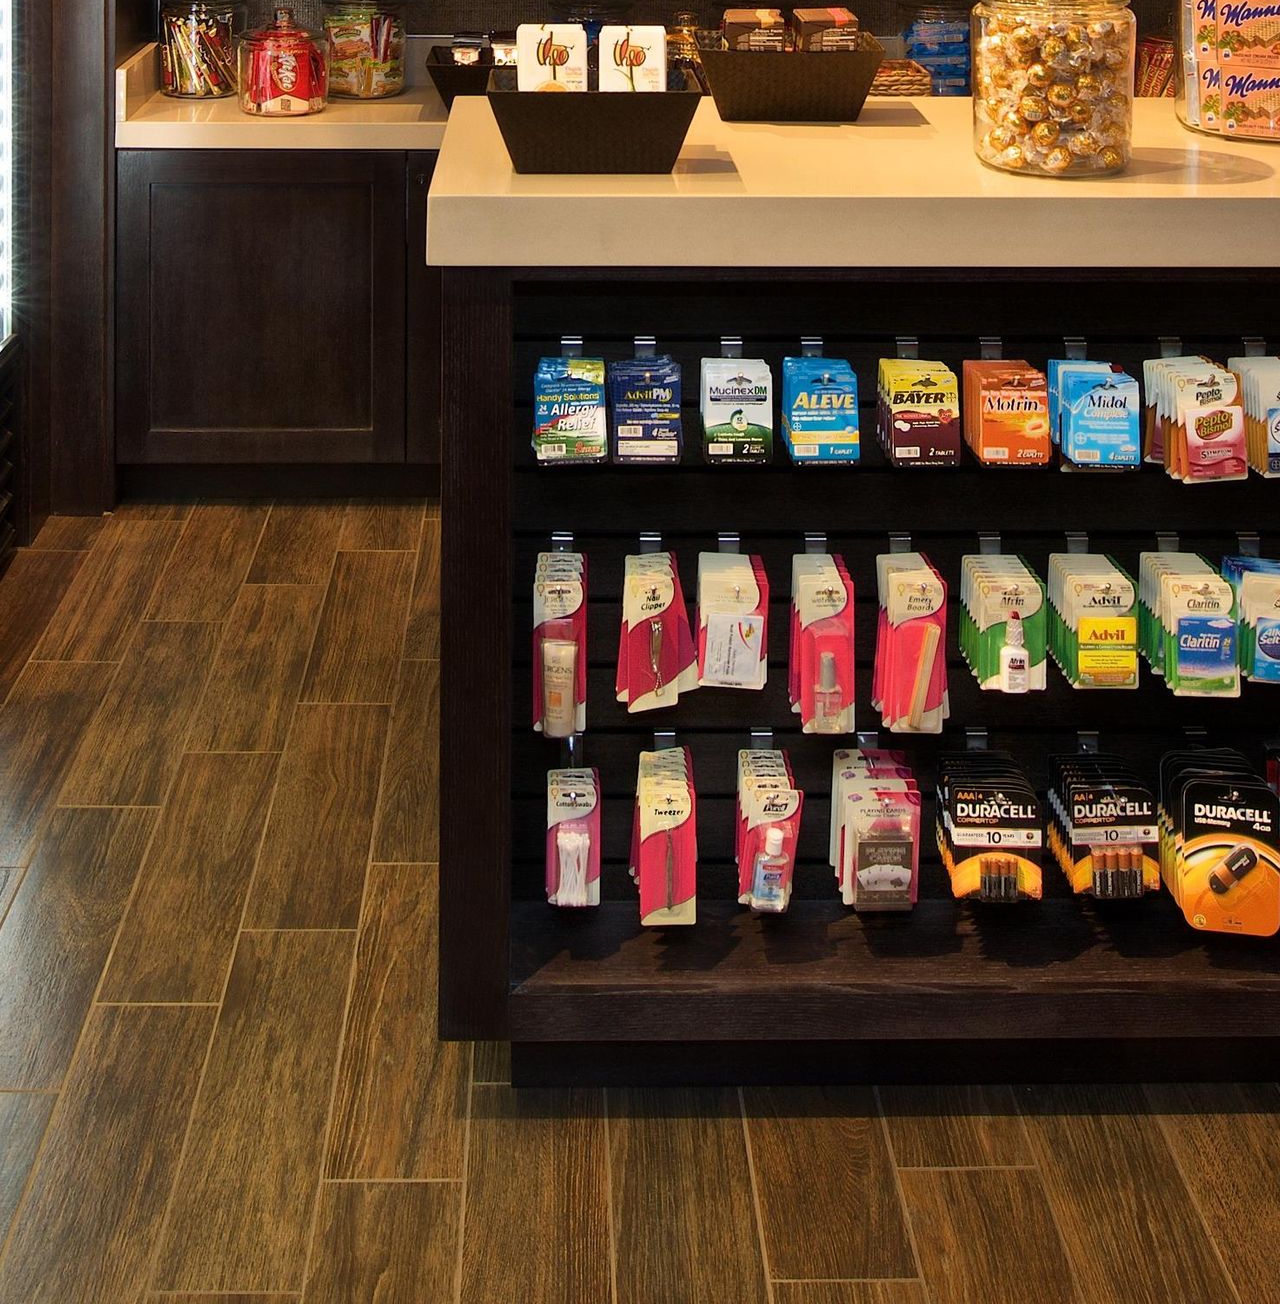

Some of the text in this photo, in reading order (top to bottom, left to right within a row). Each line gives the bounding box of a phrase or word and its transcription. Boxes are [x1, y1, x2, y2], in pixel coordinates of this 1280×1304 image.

[624, 388, 671, 402] Advil PM
[710, 386, 767, 394] Mucinex DM
[537, 394, 561, 402] Handy
[793, 392, 855, 409] ALEVE
[892, 392, 946, 405] BAYER
[1087, 394, 1128, 409] Midol
[985, 396, 1039, 412] Motrin
[551, 403, 598, 416] Allergy
[1084, 408, 1130, 420] Complete
[558, 418, 596, 431] Relief
[1200, 420, 1233, 438] Bismol
[742, 444, 749, 454] 2
[929, 448, 934, 456] 2
[1017, 449, 1022, 458] 2
[1109, 451, 1115, 461] 4
[544, 595, 577, 606] JERGENS
[646, 594, 661, 603] Nail
[907, 595, 933, 606] Emery
[1000, 597, 1024, 606] Afrin
[1089, 596, 1122, 605] Advil
[1187, 598, 1220, 609] Claritin
[640, 601, 666, 611] Clipper
[906, 603, 935, 613] Boards
[1088, 629, 1126, 641] Advil
[1180, 634, 1220, 649] Claritin
[1009, 658, 1026, 666] Afrin
[957, 792, 975, 800] AAA
[1074, 793, 1086, 801] AA
[574, 800, 592, 808] Swabs
[1073, 801, 1151, 817] DURACELL
[654, 807, 685, 817] Tweezer
[956, 802, 1036, 818] DURACELL
[1194, 803, 1271, 823] DURACELL
[1253, 823, 1271, 832] 4GB
[986, 832, 1002, 844] 10
[1104, 830, 1119, 842] 10
[865, 847, 907, 856] PLAYING
[869, 855, 903, 863] CARDS
